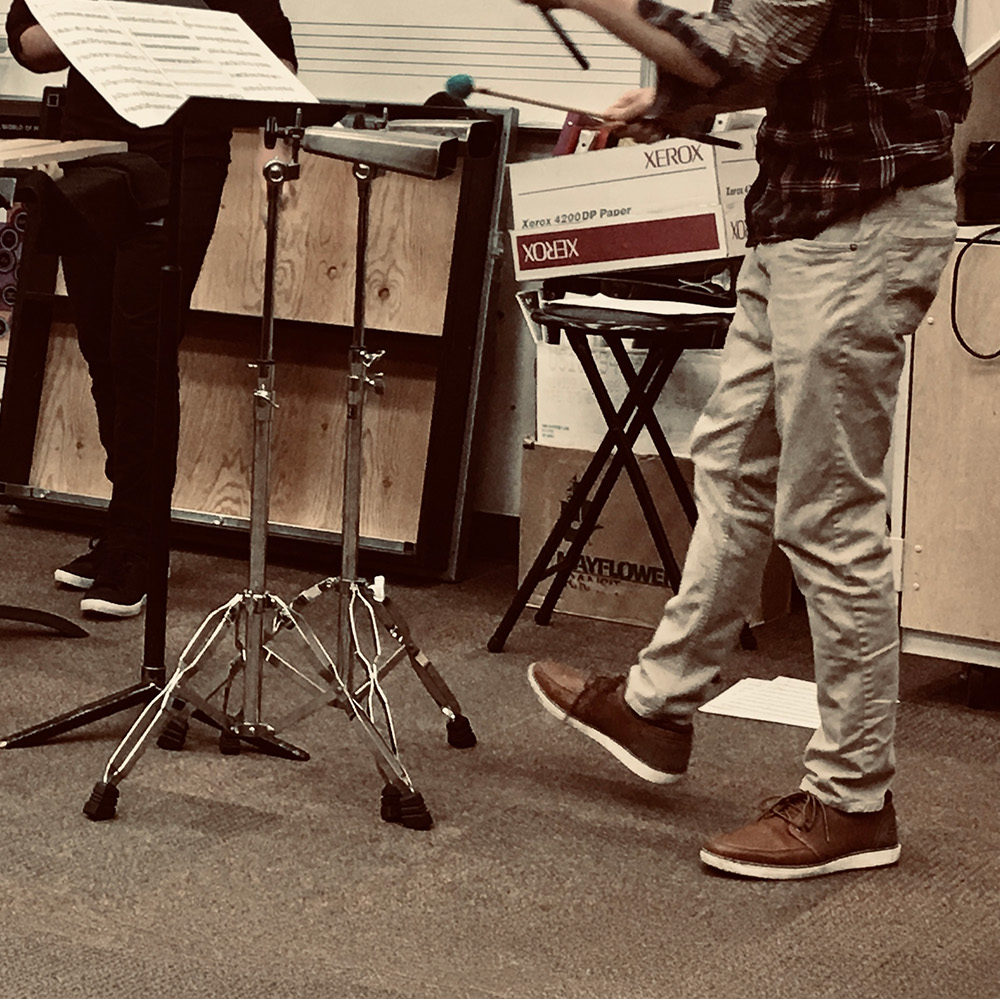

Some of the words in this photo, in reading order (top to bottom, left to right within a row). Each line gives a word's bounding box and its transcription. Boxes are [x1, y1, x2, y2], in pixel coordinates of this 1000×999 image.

[643, 143, 704, 170] XEROX
[522, 218, 552, 229] Xerox
[599, 206, 632, 218] Paper
[522, 238, 580, 262] XEROX
[556, 551, 672, 588] AYFLOWE
